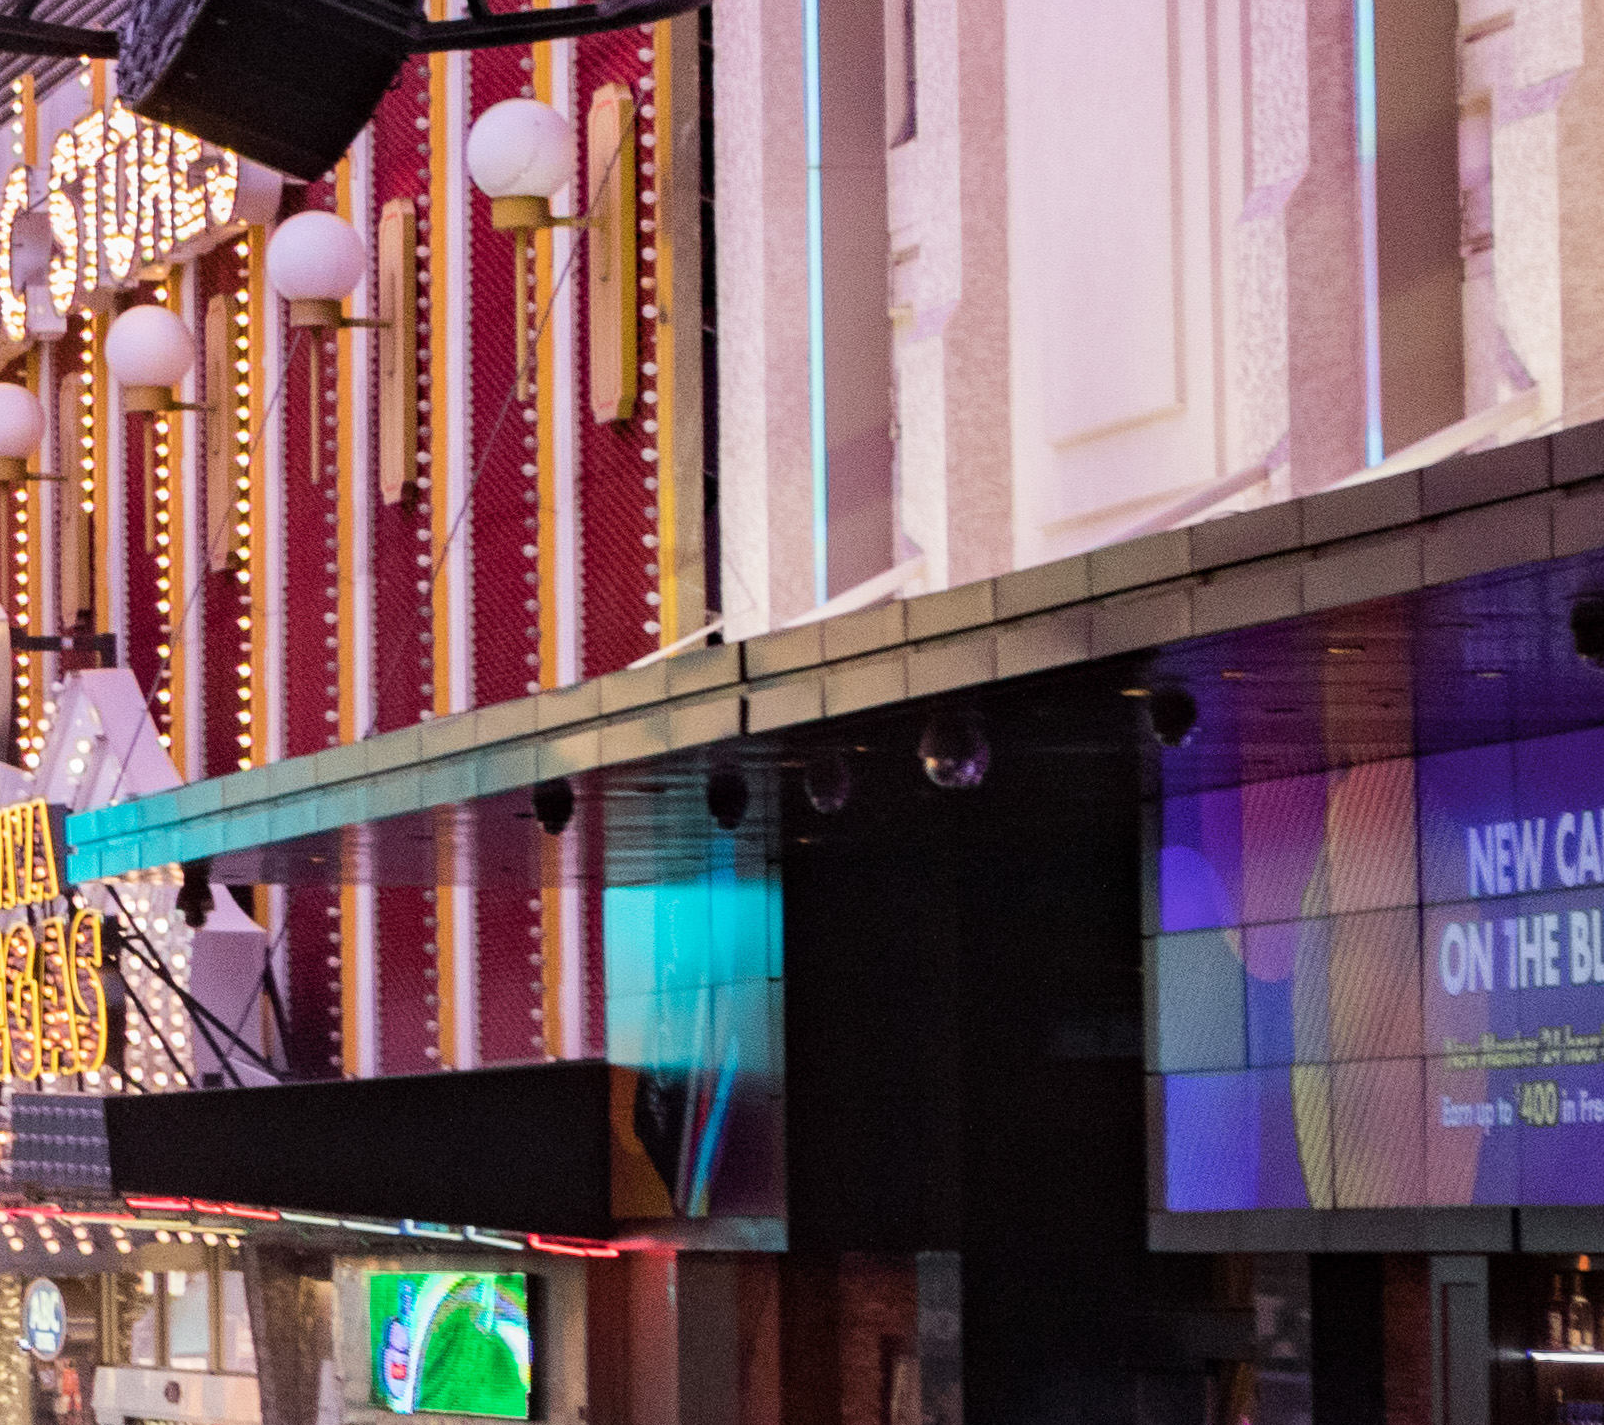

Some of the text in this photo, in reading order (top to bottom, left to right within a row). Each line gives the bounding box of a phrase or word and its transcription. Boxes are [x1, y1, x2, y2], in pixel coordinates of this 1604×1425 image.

[1468, 810, 1604, 899] NEW CA
[1439, 919, 1494, 995] ON
[1502, 911, 1560, 990] THE
